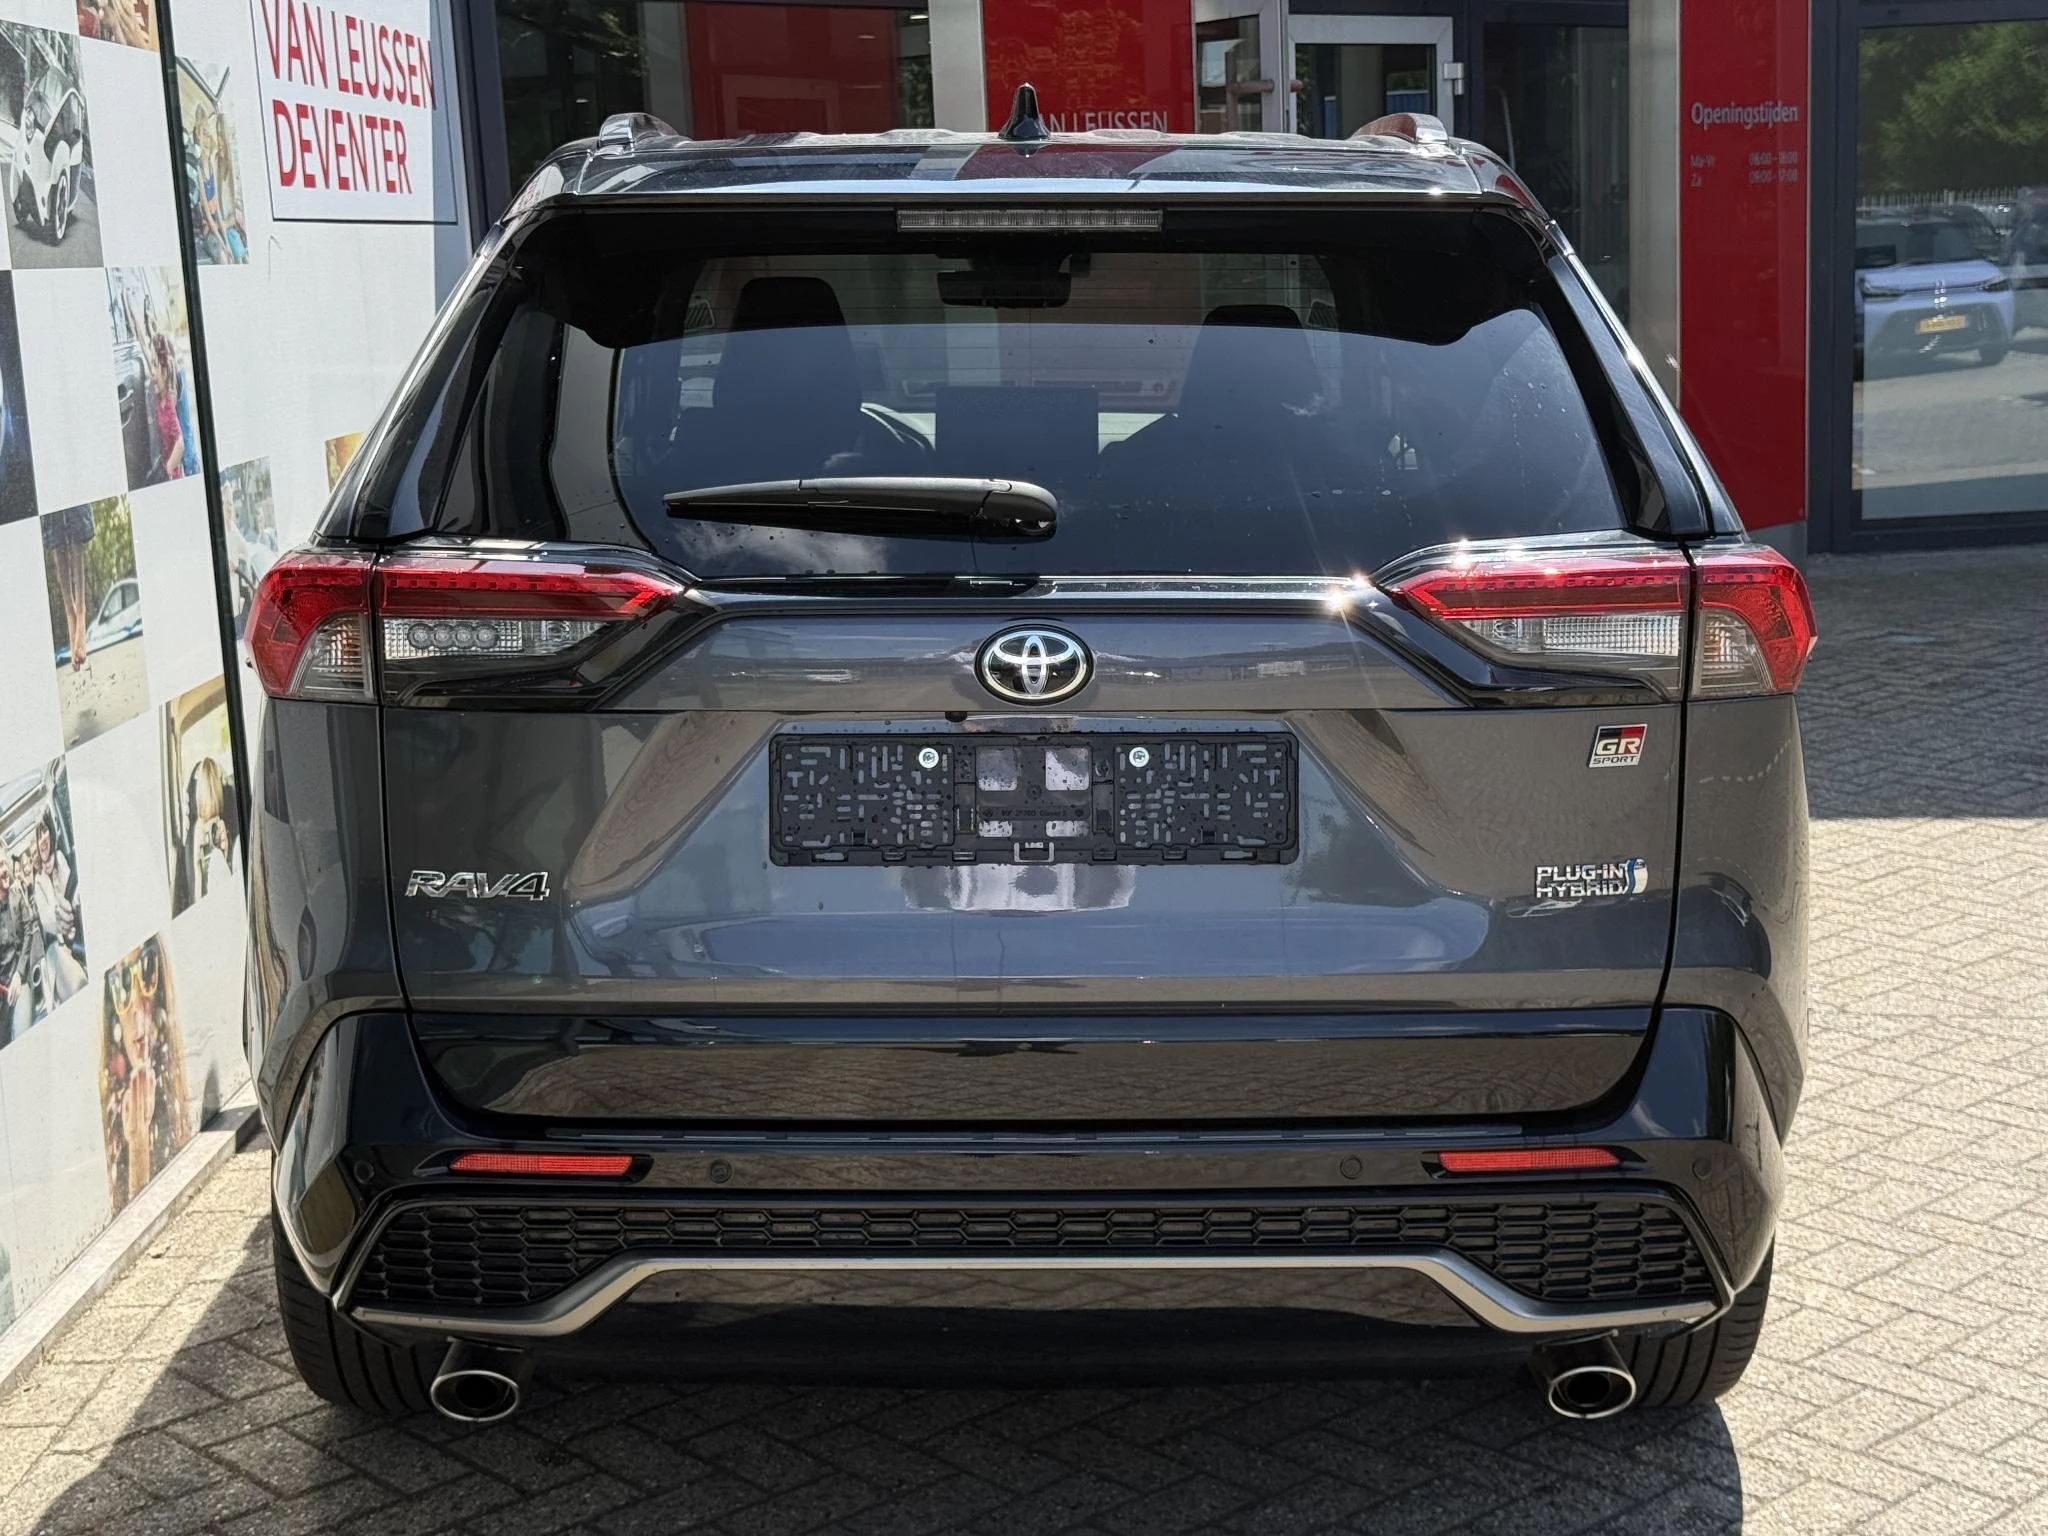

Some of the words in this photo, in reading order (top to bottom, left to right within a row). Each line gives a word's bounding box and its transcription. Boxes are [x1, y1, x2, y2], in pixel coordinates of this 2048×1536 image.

[260, 0, 329, 89] VAN
[331, 11, 437, 111] LEUSSEN
[1690, 101, 1798, 130] Openingstijden
[272, 99, 412, 194] DEVENTER
[1595, 737, 1641, 755] GR
[1592, 756, 1639, 765] SPORT
[1536, 863, 1626, 882] PLUG-IN
[404, 870, 551, 901] RAV4
[1536, 880, 1623, 899] HYBRID
